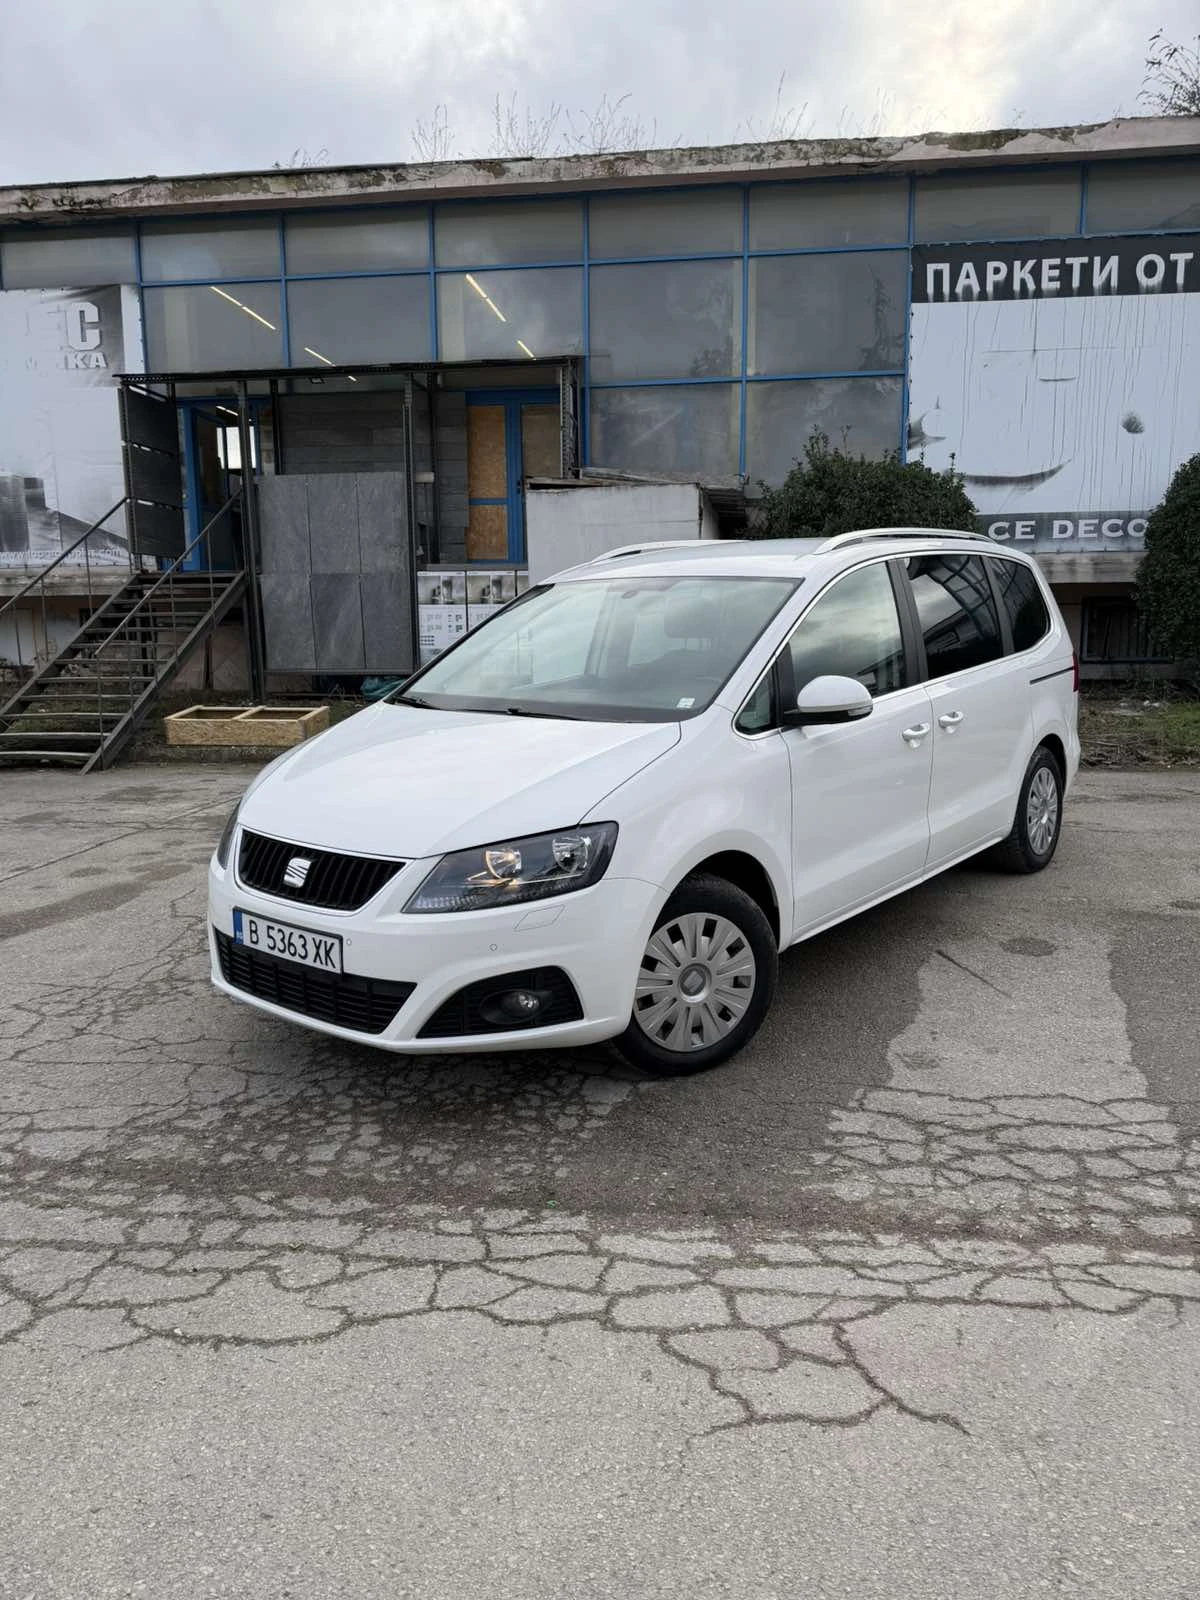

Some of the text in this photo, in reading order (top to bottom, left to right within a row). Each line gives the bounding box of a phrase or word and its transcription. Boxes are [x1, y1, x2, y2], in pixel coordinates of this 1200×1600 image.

[926, 252, 1194, 300] ПАРКЕТИ ОТ
[249, 919, 260, 945] B
[266, 925, 309, 960] 5363
[312, 937, 337, 969] XK
